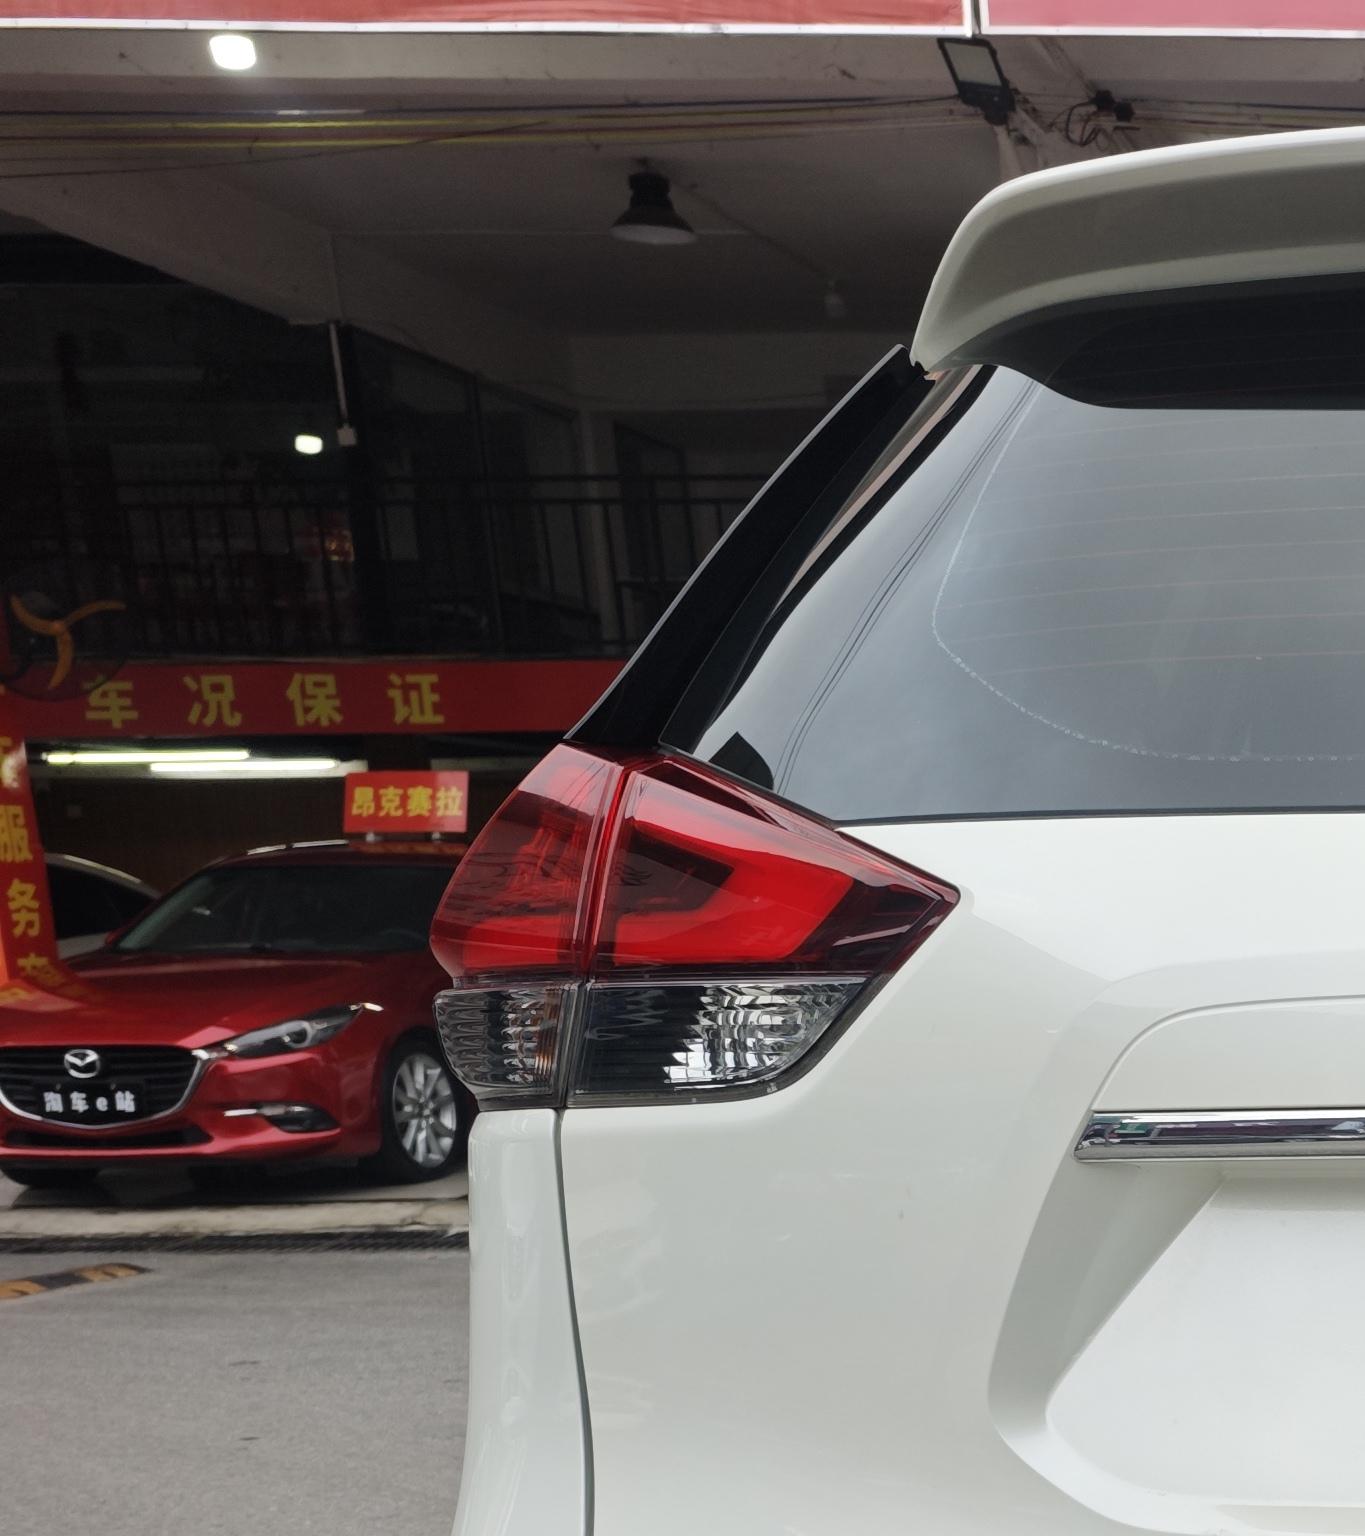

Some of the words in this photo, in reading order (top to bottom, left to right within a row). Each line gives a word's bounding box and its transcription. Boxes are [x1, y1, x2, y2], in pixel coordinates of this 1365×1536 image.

[83, 671, 446, 729] 车况保证
[351, 784, 464, 818] 昂克赛拉
[43, 1090, 136, 1113] 淘车e站
